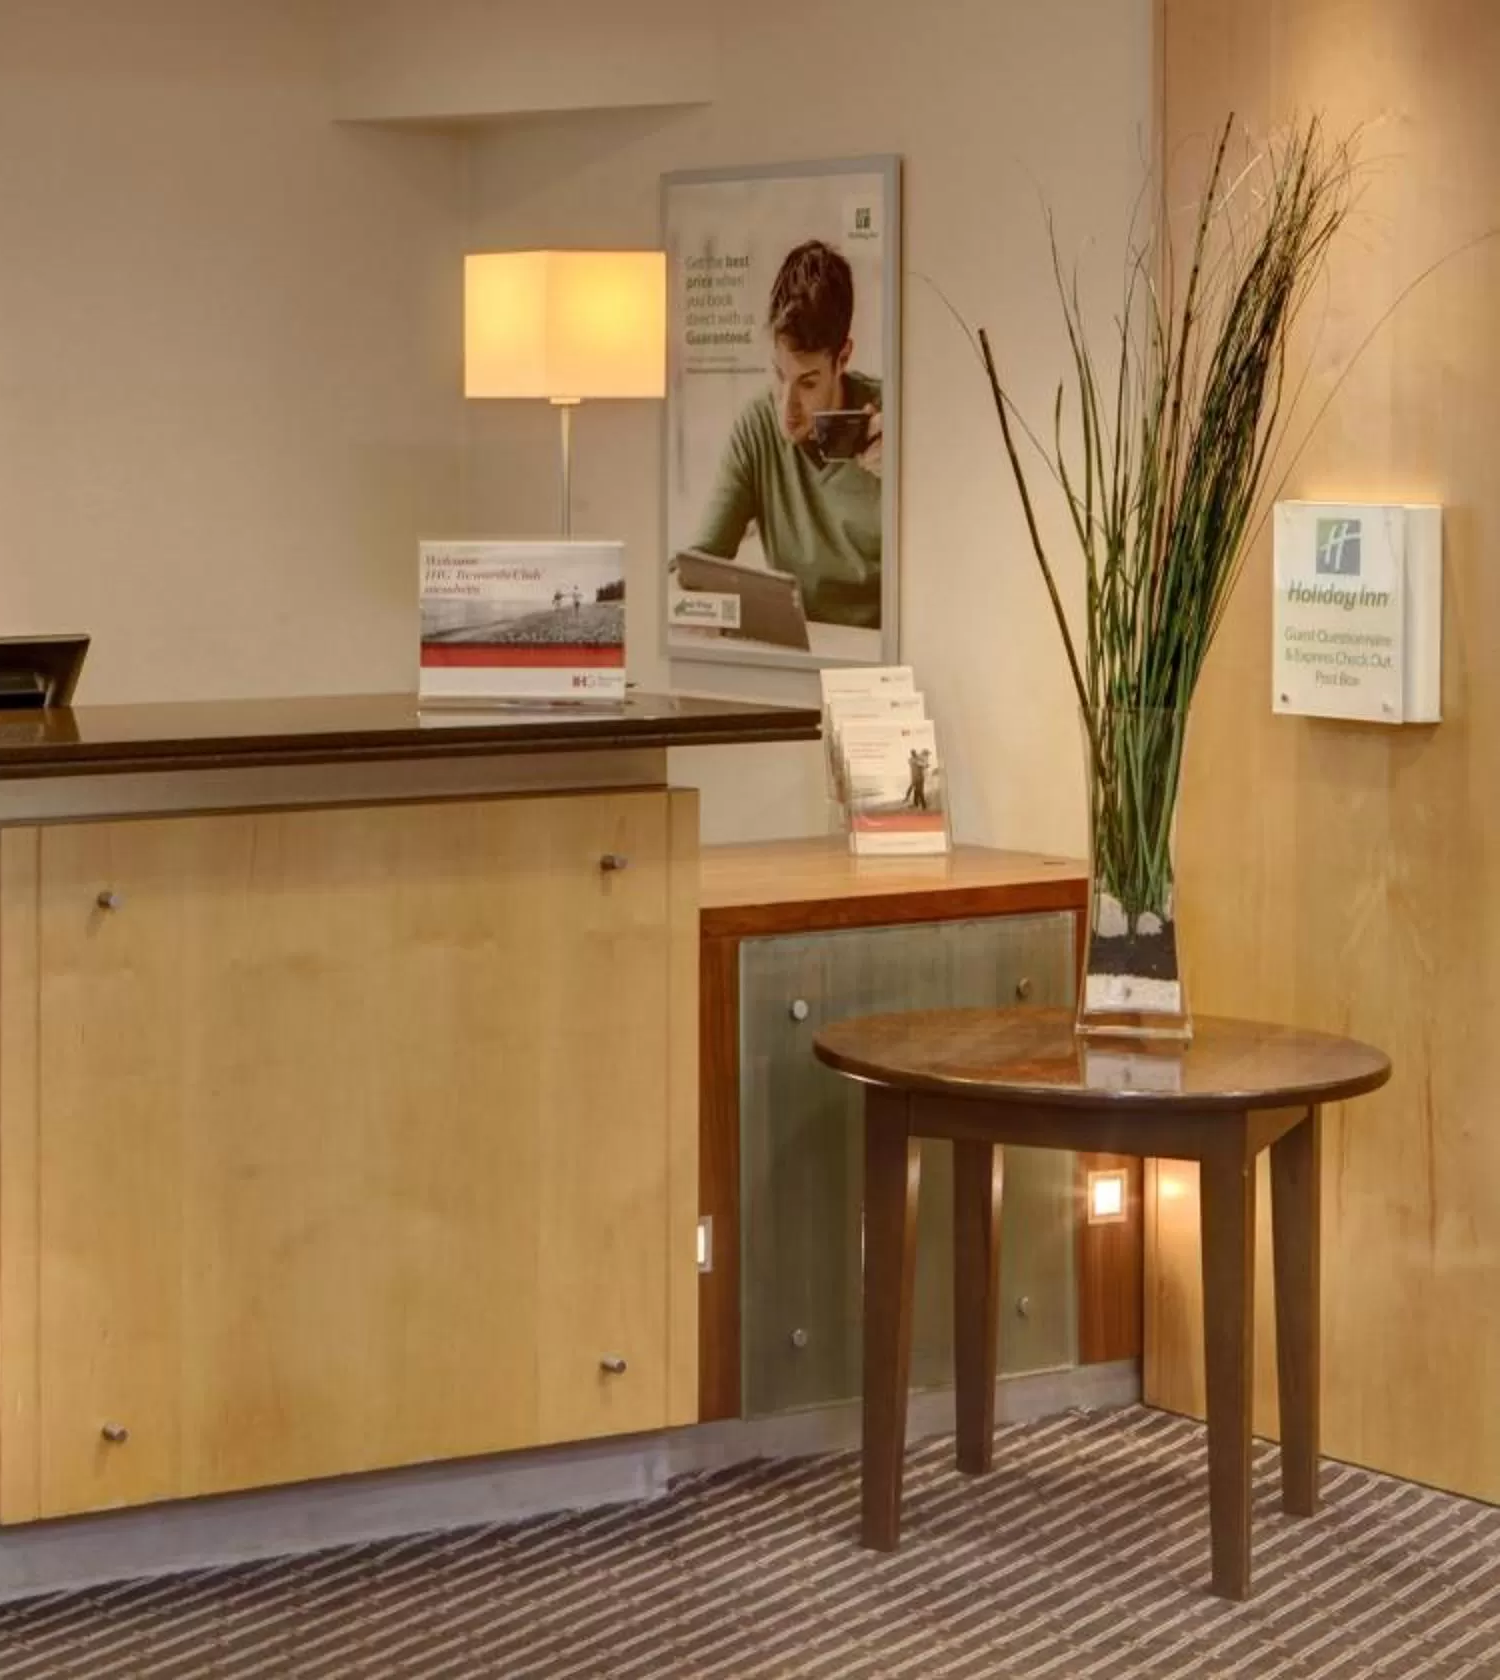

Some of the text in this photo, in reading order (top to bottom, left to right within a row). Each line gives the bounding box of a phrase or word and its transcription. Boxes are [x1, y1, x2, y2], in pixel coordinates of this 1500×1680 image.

[725, 255, 750, 268] best
[1287, 578, 1391, 611] Holiday Inn
